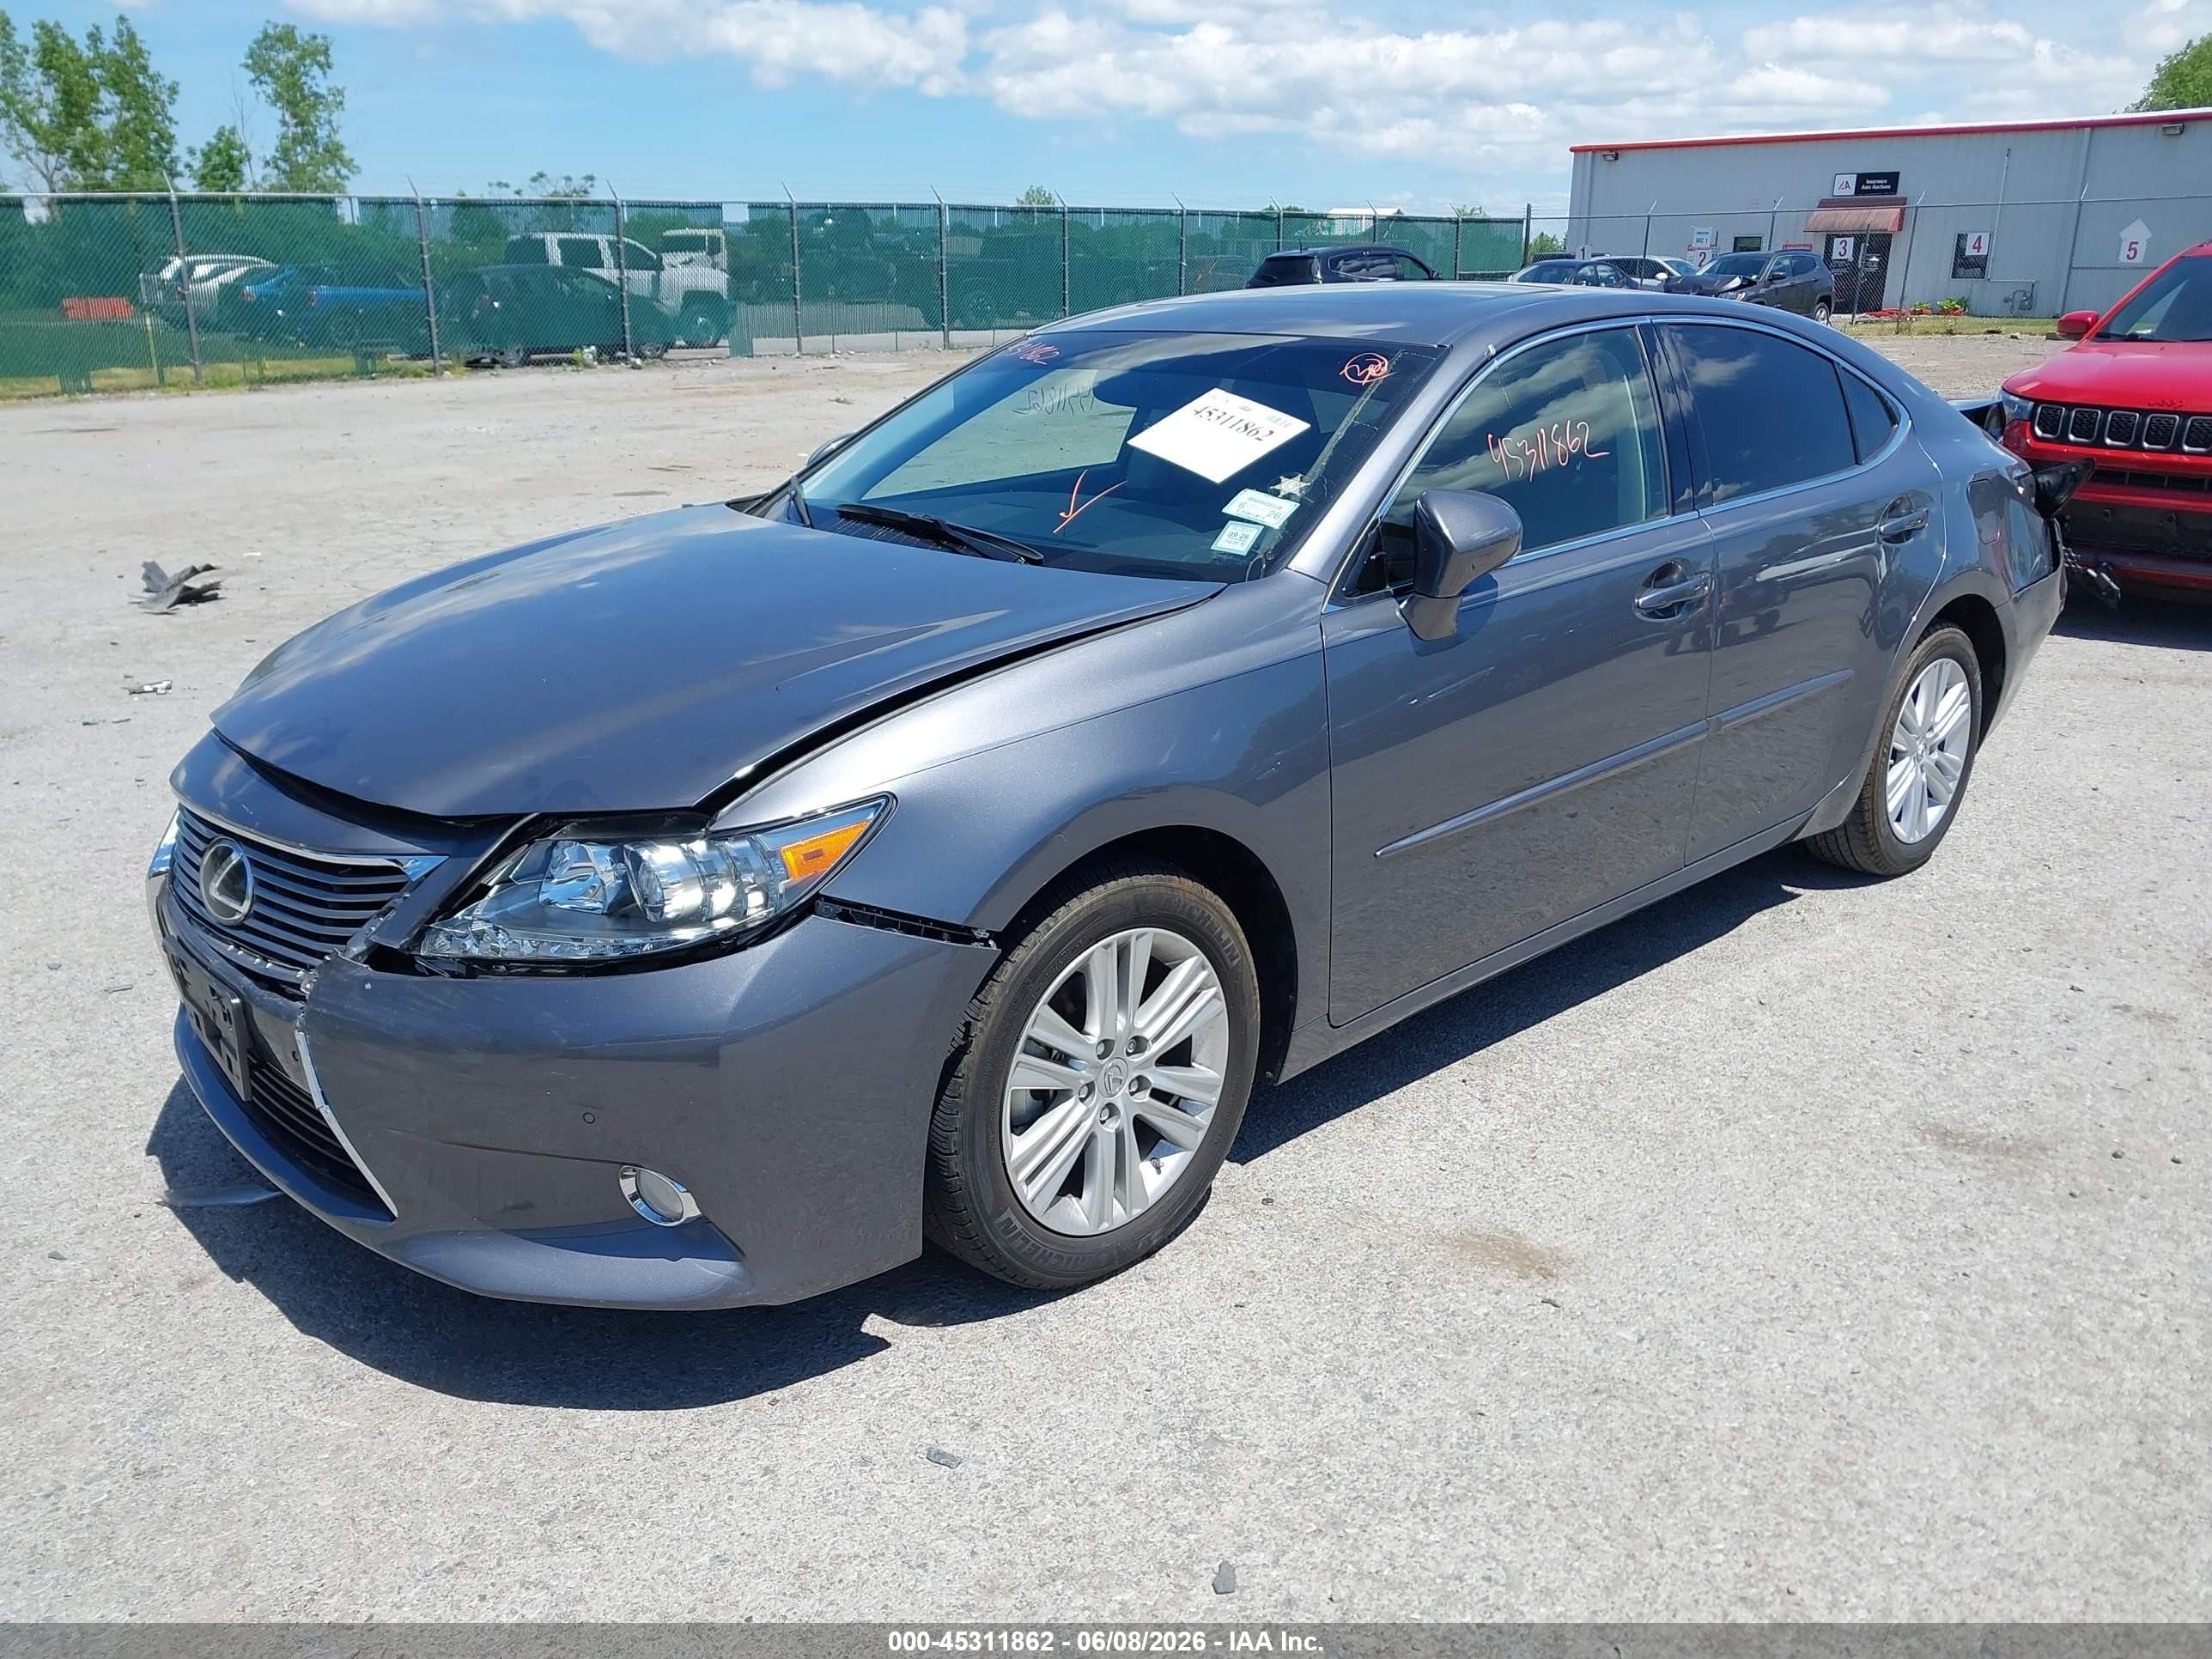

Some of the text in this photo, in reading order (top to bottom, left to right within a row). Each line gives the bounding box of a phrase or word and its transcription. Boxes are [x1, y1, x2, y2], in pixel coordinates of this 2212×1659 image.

[1580, 246, 1586, 260] 1
[1838, 240, 1848, 257] 3
[1972, 234, 1983, 253] 4
[2125, 240, 2139, 260] 5
[1698, 252, 1707, 267] 2
[1193, 405, 1275, 441] 45311862
[1486, 418, 1611, 482] 45311862
[1267, 510, 1283, 520] 26
[1164, 894, 1242, 963] MICHELIN
[994, 1212, 1095, 1269] MICHELIN
